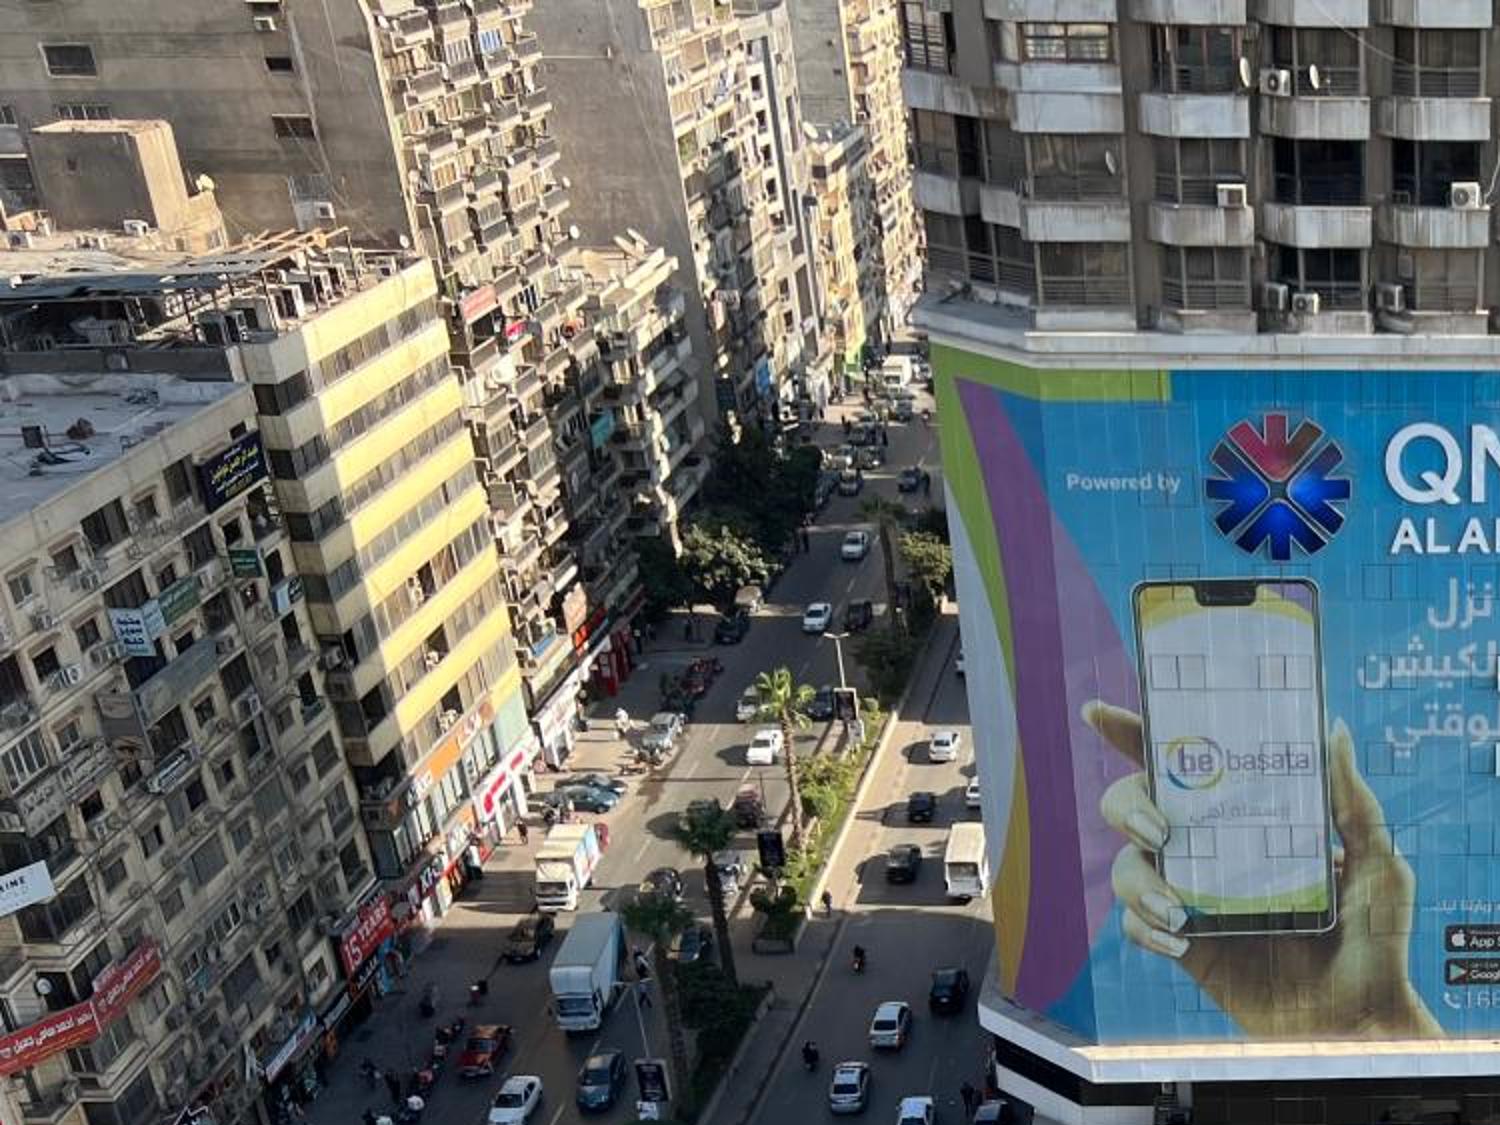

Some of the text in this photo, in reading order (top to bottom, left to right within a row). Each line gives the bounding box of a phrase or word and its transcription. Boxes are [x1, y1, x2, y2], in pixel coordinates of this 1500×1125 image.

[1066, 472, 1182, 494] Powered by
[1427, 577, 1493, 630] نزل
[1226, 748, 1310, 771] basata
[1469, 936, 1496, 948] App
